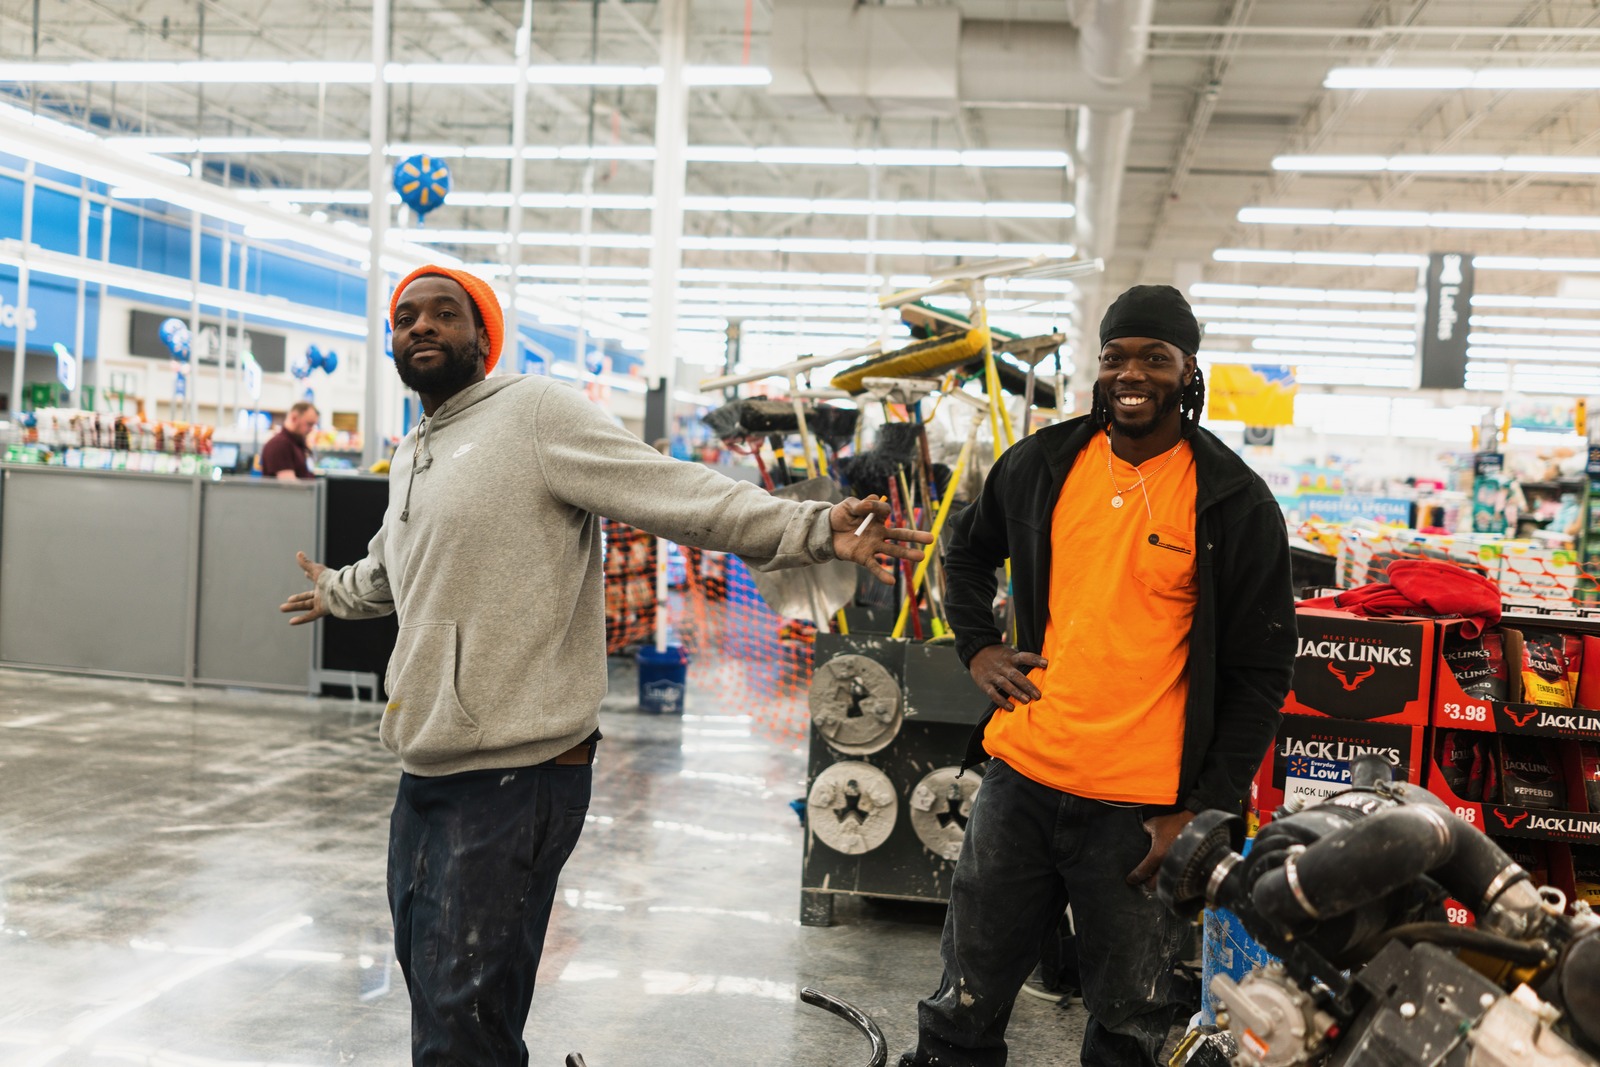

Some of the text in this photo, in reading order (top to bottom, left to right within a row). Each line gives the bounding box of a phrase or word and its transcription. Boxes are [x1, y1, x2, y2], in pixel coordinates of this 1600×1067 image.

[1349, 636, 1383, 645] SNACKS
[1295, 637, 1412, 667] JACK LINK'S
[1527, 657, 1546, 671] JACK
[1443, 702, 1486, 722] $3.98
[1537, 712, 1577, 731] JACK
[1337, 737, 1371, 746] SNACKS
[1280, 737, 1335, 761] JACK
[1310, 760, 1336, 769] Everyday
[1505, 760, 1528, 772] JACK
[1309, 766, 1340, 781] Low
[1293, 786, 1316, 797] JACK
[1514, 786, 1554, 798] PEPPERED
[1526, 815, 1567, 833] JACK
[1446, 907, 1468, 925] 98
